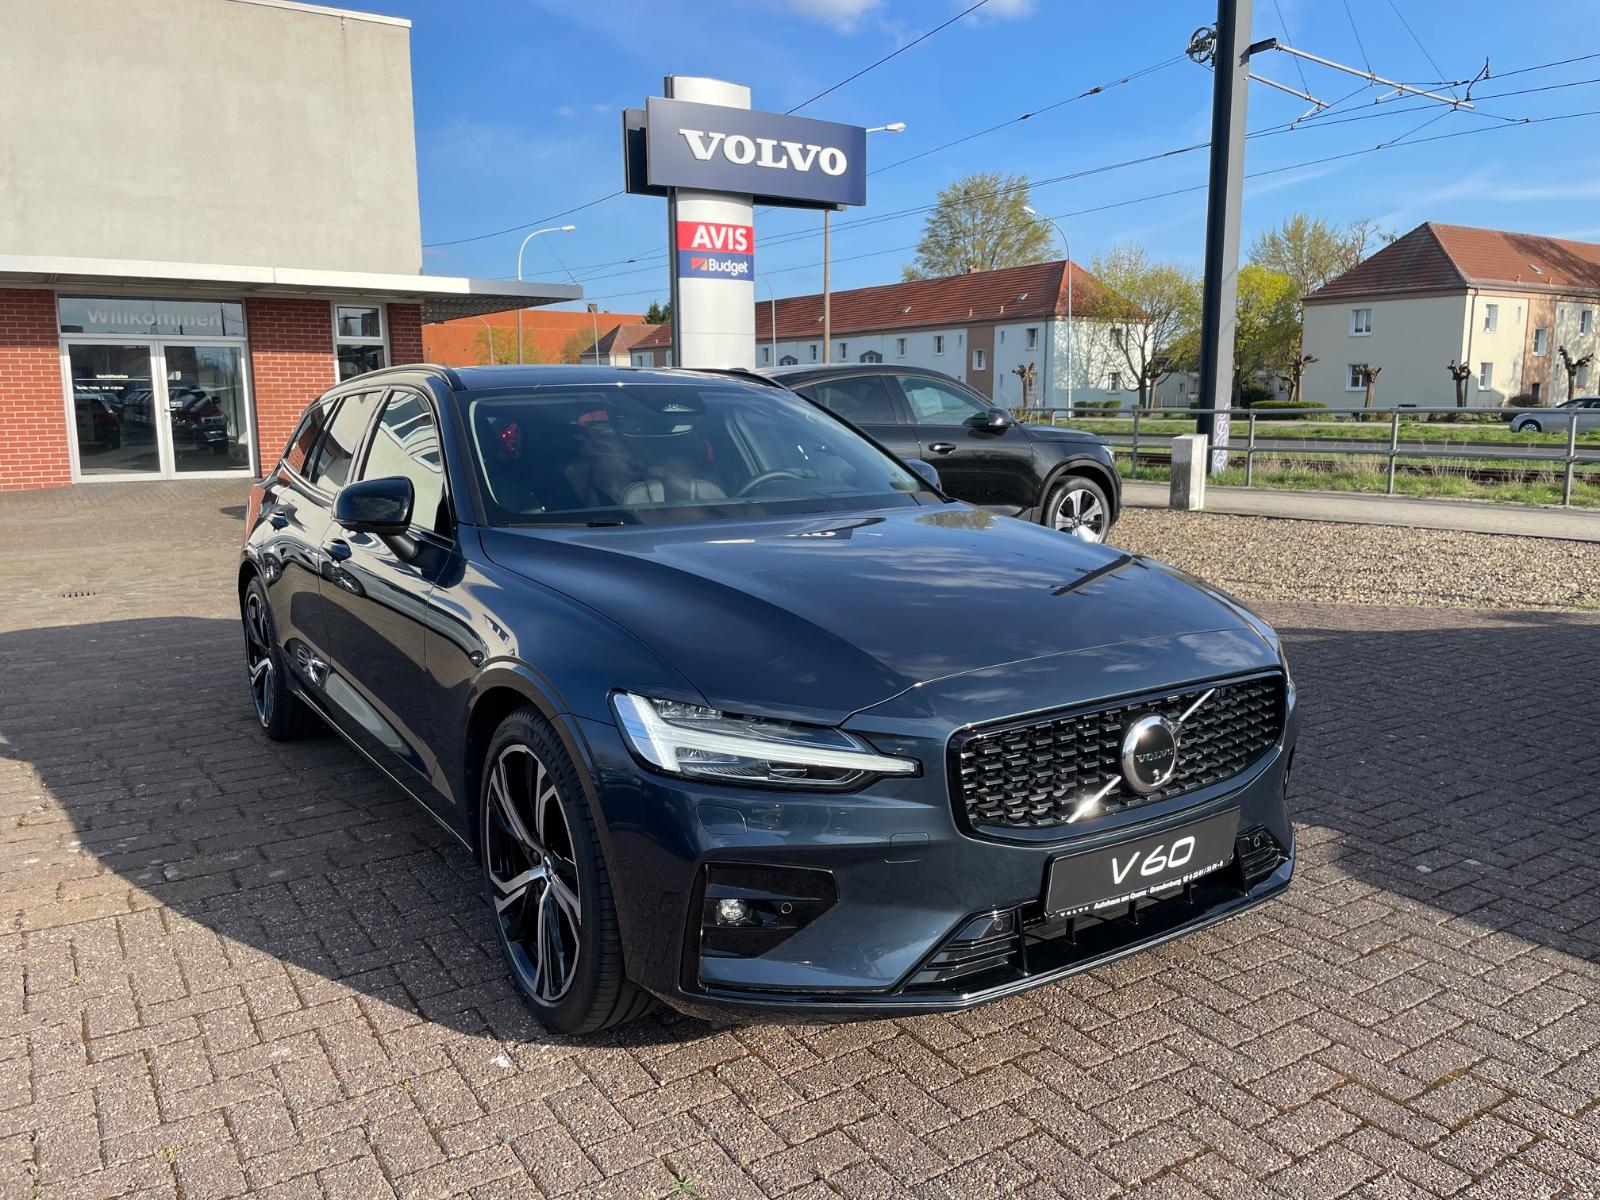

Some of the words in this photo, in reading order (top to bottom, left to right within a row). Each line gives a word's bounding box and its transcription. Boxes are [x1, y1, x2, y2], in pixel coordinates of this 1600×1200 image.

[678, 128, 848, 177] VOLVO
[691, 225, 748, 251] AVIS
[708, 258, 749, 276] Budget
[87, 308, 222, 328] Willkommen
